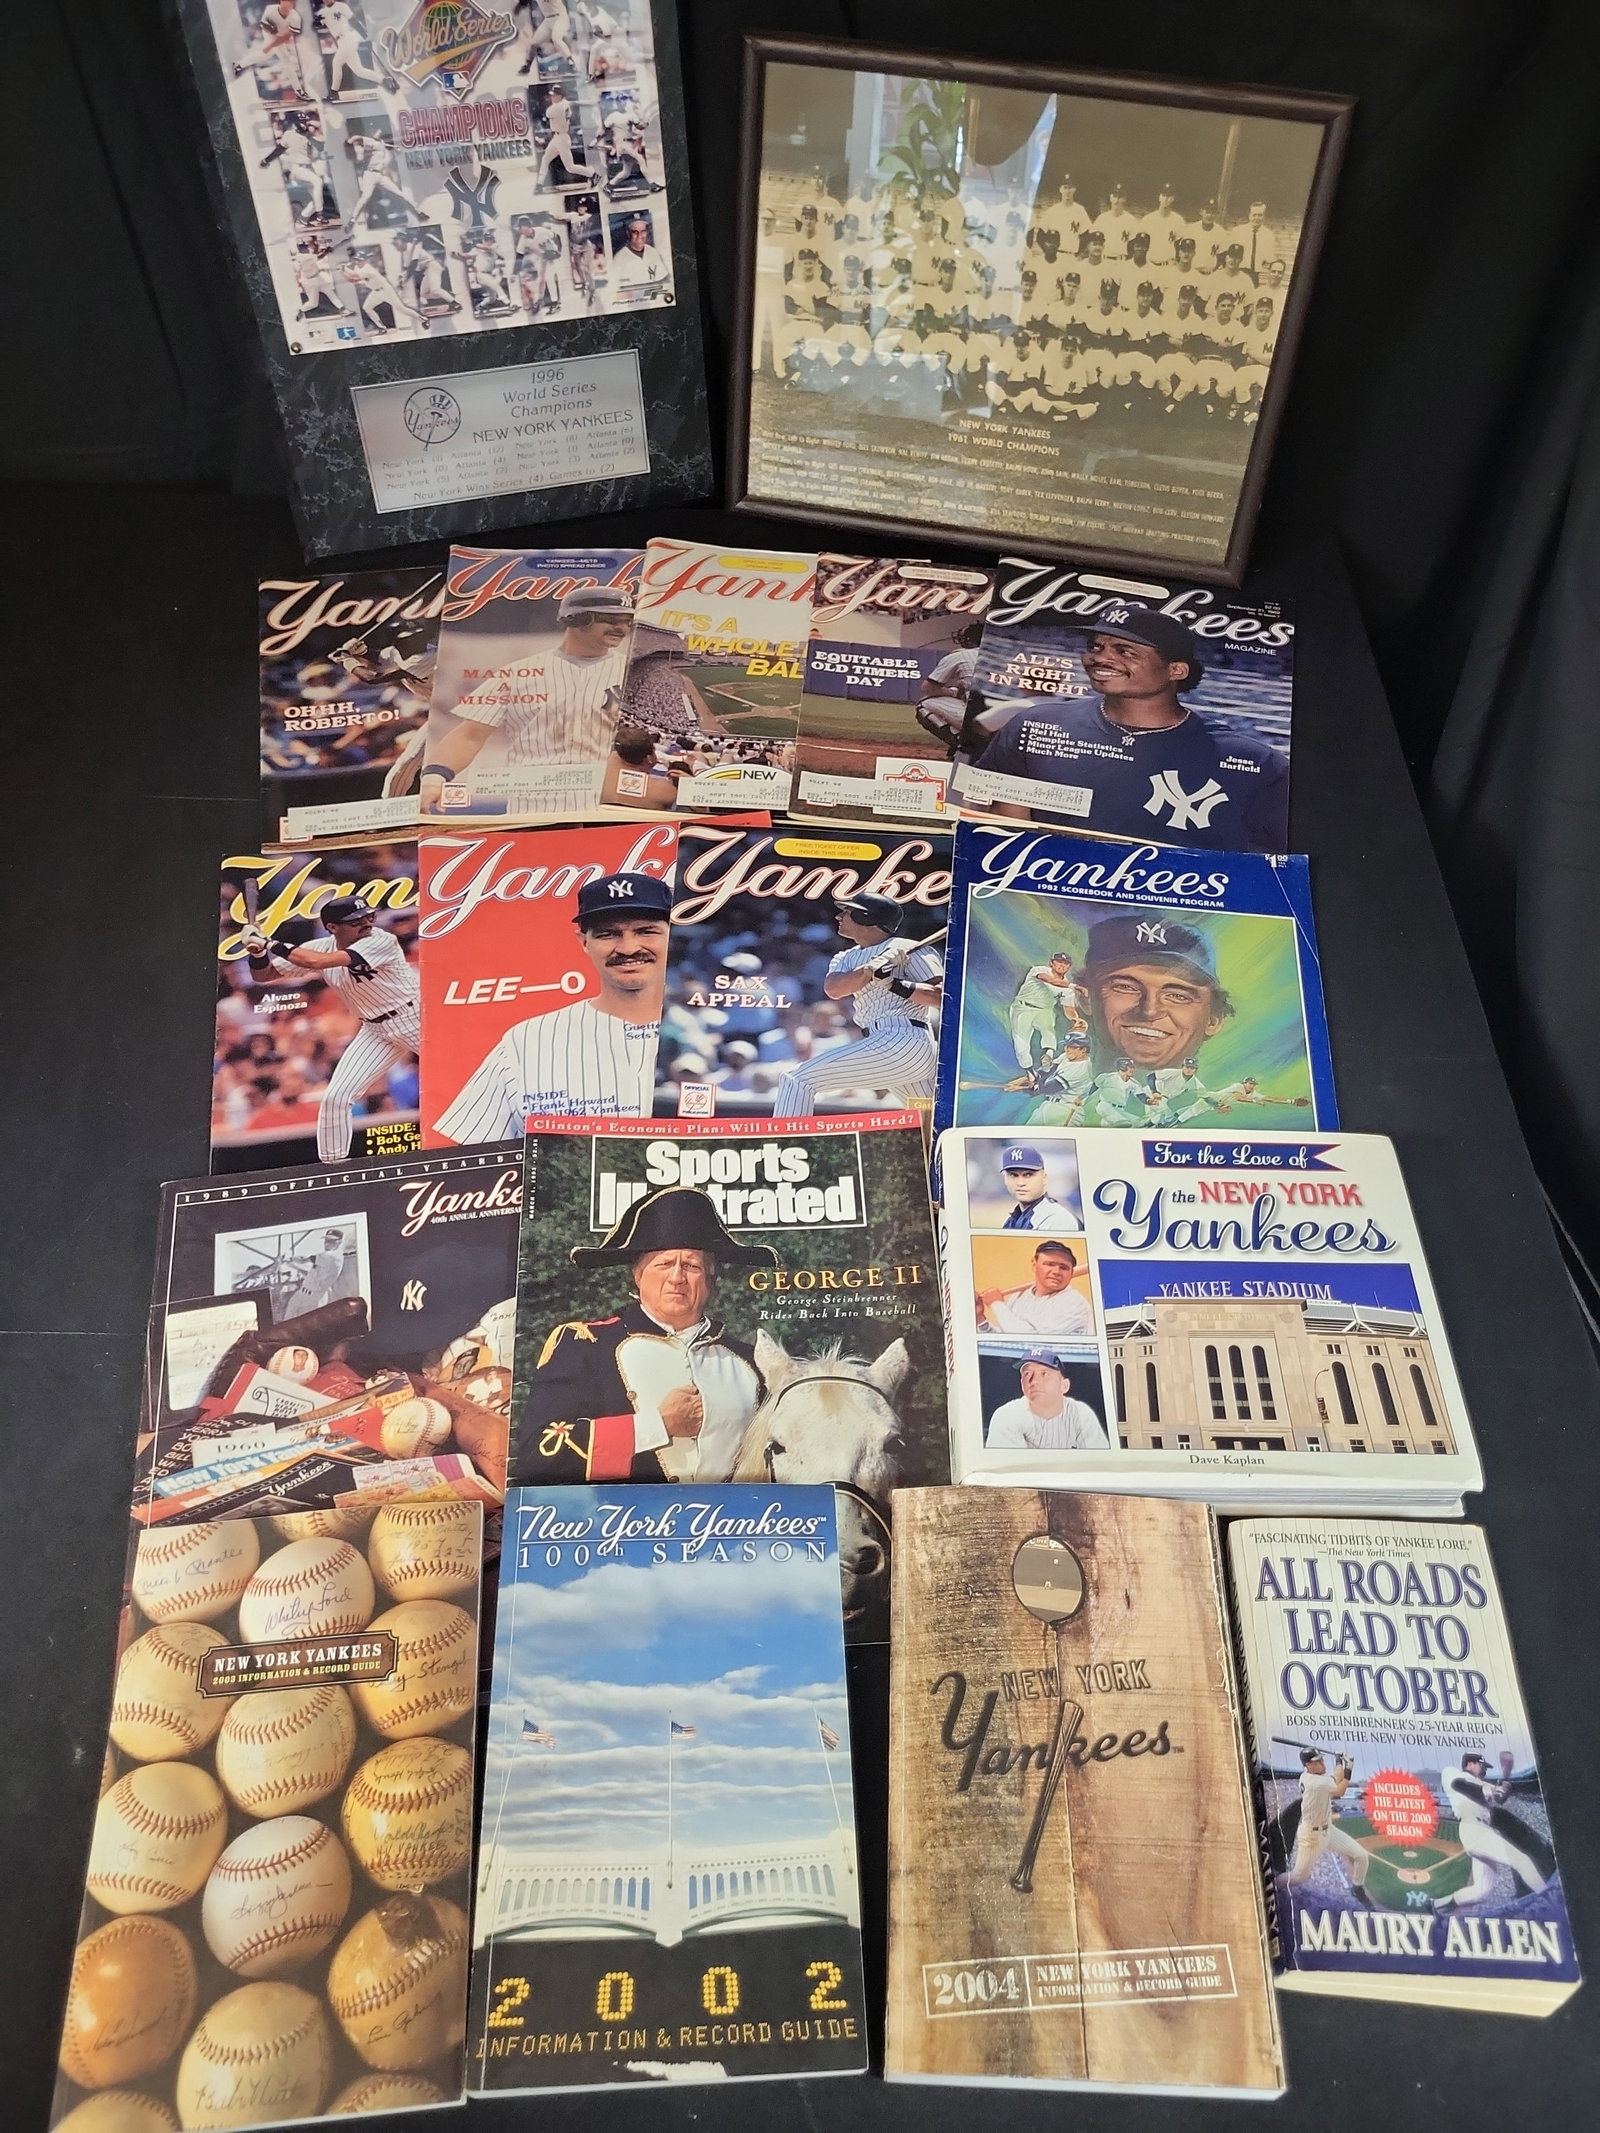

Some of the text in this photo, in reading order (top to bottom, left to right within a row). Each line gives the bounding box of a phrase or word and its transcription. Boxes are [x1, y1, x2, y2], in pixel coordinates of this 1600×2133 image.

[383, 7, 513, 68] World Series
[399, 98, 529, 148] CHAMPIONS
[404, 139, 533, 169] NEW YORK YANKEES
[531, 367, 565, 385] 1996
[503, 382, 597, 404] World Series
[511, 398, 593, 419] Champions
[473, 410, 633, 444] NEW YORK YANKEES
[959, 419, 1051, 439] NEW YORK YANKEES
[947, 432, 1060, 456] 1961 WORLD CHAMPIONS
[659, 609, 738, 633] IT'S A
[687, 634, 798, 657] WHOLE
[1224, 643, 1277, 656] MAGAZINE
[815, 651, 919, 670] EQUITABLE
[1012, 652, 1073, 670] ALL'S
[463, 667, 544, 678] MAN ON
[810, 661, 922, 680] OLD TIMERS
[1004, 663, 1076, 683] RIGHT
[496, 681, 511, 692] A
[845, 675, 885, 688] DAY
[988, 672, 1088, 696] IN RIGHT
[458, 693, 549, 706] MISSION
[283, 701, 361, 719] OHHH,
[284, 709, 401, 732] ROBERTO!
[1023, 720, 1063, 732] INSIDE:
[1029, 727, 1069, 739] Mel Hall
[1026, 746, 1079, 760] Much More
[1027, 740, 1135, 762] Minor League Updates
[1028, 734, 1123, 753] Complete Statistics
[1219, 761, 1261, 774] Barfield
[1225, 755, 1254, 766] Jesse
[743, 770, 777, 781] NEW
[971, 825, 1230, 900] Yankees
[1037, 884, 1225, 908] 1982 SCOREBOOK AND SOUVENIR PROGRAM
[714, 974, 768, 991] SAX
[260, 991, 301, 1004] Alvaro
[687, 992, 792, 1010] APPEAL
[253, 1000, 308, 1015] Espinoza
[523, 1091, 568, 1102] INSIDE
[531, 1096, 615, 1111] Frank Howard
[558, 1103, 641, 1116] 1962 Yankees
[366, 1123, 416, 1137] INSIDE:
[533, 1114, 914, 1134] Clinton's Economic Plan: Will It Hit Sports Hard?
[376, 1133, 401, 1146] Bob
[376, 1144, 408, 1156] Andy
[1153, 1142, 1308, 1168] For the Love of
[646, 1141, 810, 1187] Sports
[184, 1187, 249, 1203] 1989
[269, 1168, 403, 1193] OFFICIAL
[1171, 1181, 1363, 1207] the NEW YORK
[528, 1196, 536, 1220] MARCH
[1092, 1178, 1397, 1254] Yankees
[430, 1215, 447, 1224] 40th
[449, 1213, 478, 1222] ANNUAL
[749, 1265, 922, 1291] GEORGE II
[776, 1293, 897, 1307] George Steinbrenner
[1159, 1281, 1333, 1300] YANKEE STADIUM
[759, 1304, 917, 1320] Rides Back Into Baseball
[217, 1442, 266, 1454] 1960
[1188, 1454, 1265, 1467] Dave Kaplan
[259, 1460, 336, 1496] Yankees
[515, 1504, 594, 1541] New
[595, 1503, 682, 1557] York
[1328, 1535, 1372, 1546] TIDBITS
[1375, 1536, 1390, 1546] OF
[1392, 1537, 1435, 1548] YANKEE
[651, 1541, 826, 1564] SEASON
[1345, 1548, 1364, 1557] New
[1366, 1549, 1385, 1557] York
[1386, 1549, 1411, 1558] Times
[1255, 1556, 1488, 1610] ALL ROADS
[1283, 1608, 1471, 1663] LEAD TO
[213, 1643, 382, 1673] NEW YORK YANKEES
[212, 1675, 236, 1685] 2003
[238, 1668, 301, 1682] INFORMATION
[312, 1664, 350, 1675] RECORD
[352, 1661, 381, 1671] GUIDE
[1000, 1659, 1151, 1702] NEW YORK
[1279, 1660, 1500, 1719] OCTOBER
[1286, 1715, 1503, 1735] BOSS STEINBRENNER'S 25-YEAR REIGN
[1309, 1730, 1486, 1749] OVER THE NEW YORK YANKEES
[1374, 1783, 1421, 1796] INCLUDES
[1373, 1796, 1426, 1810] THE LATEST
[1373, 1811, 1432, 1824] ON THE 2000
[1386, 1825, 1423, 1837] SEASON
[1299, 1909, 1563, 1965] MAURY ALLEN
[1036, 1955, 1217, 1982] NEW YORK YANKEES
[932, 1967, 1020, 2006] 2004
[1038, 1975, 1222, 1998] INFORMATION & RECORD GUIDE
[475, 2017, 859, 2060] INFORMATION & RECORD GUIDE
